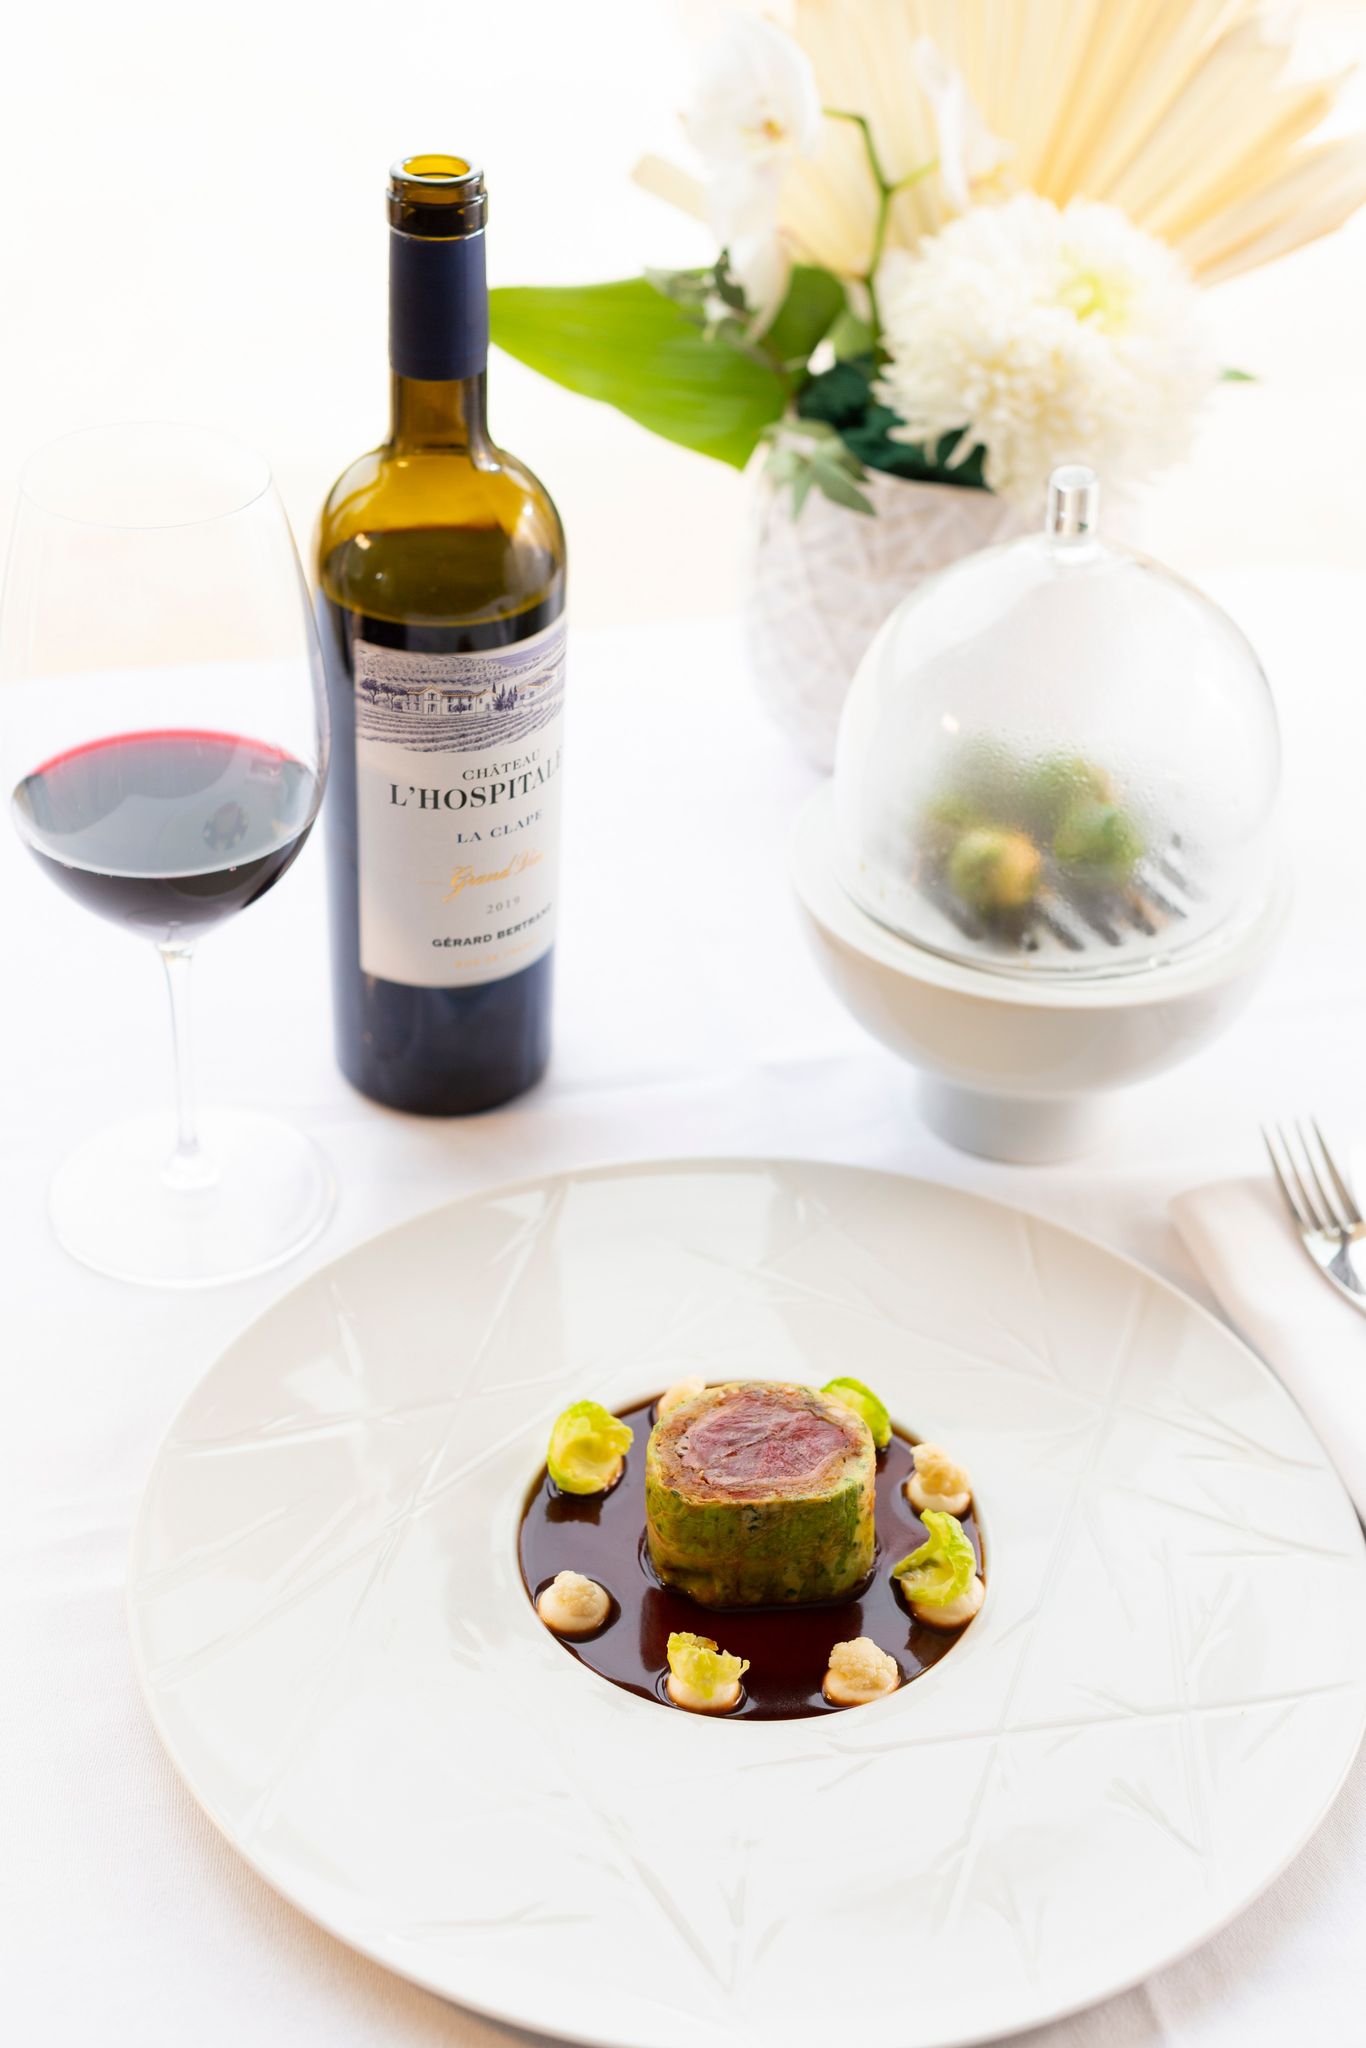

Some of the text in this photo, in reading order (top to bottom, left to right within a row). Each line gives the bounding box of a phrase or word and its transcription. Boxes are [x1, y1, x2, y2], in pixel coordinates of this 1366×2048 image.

[462, 749, 540, 781] CHÂTEAU
[457, 809, 543, 844] LA CLAPE
[486, 896, 521, 915] 2019
[431, 934, 493, 948] GÉRARD
